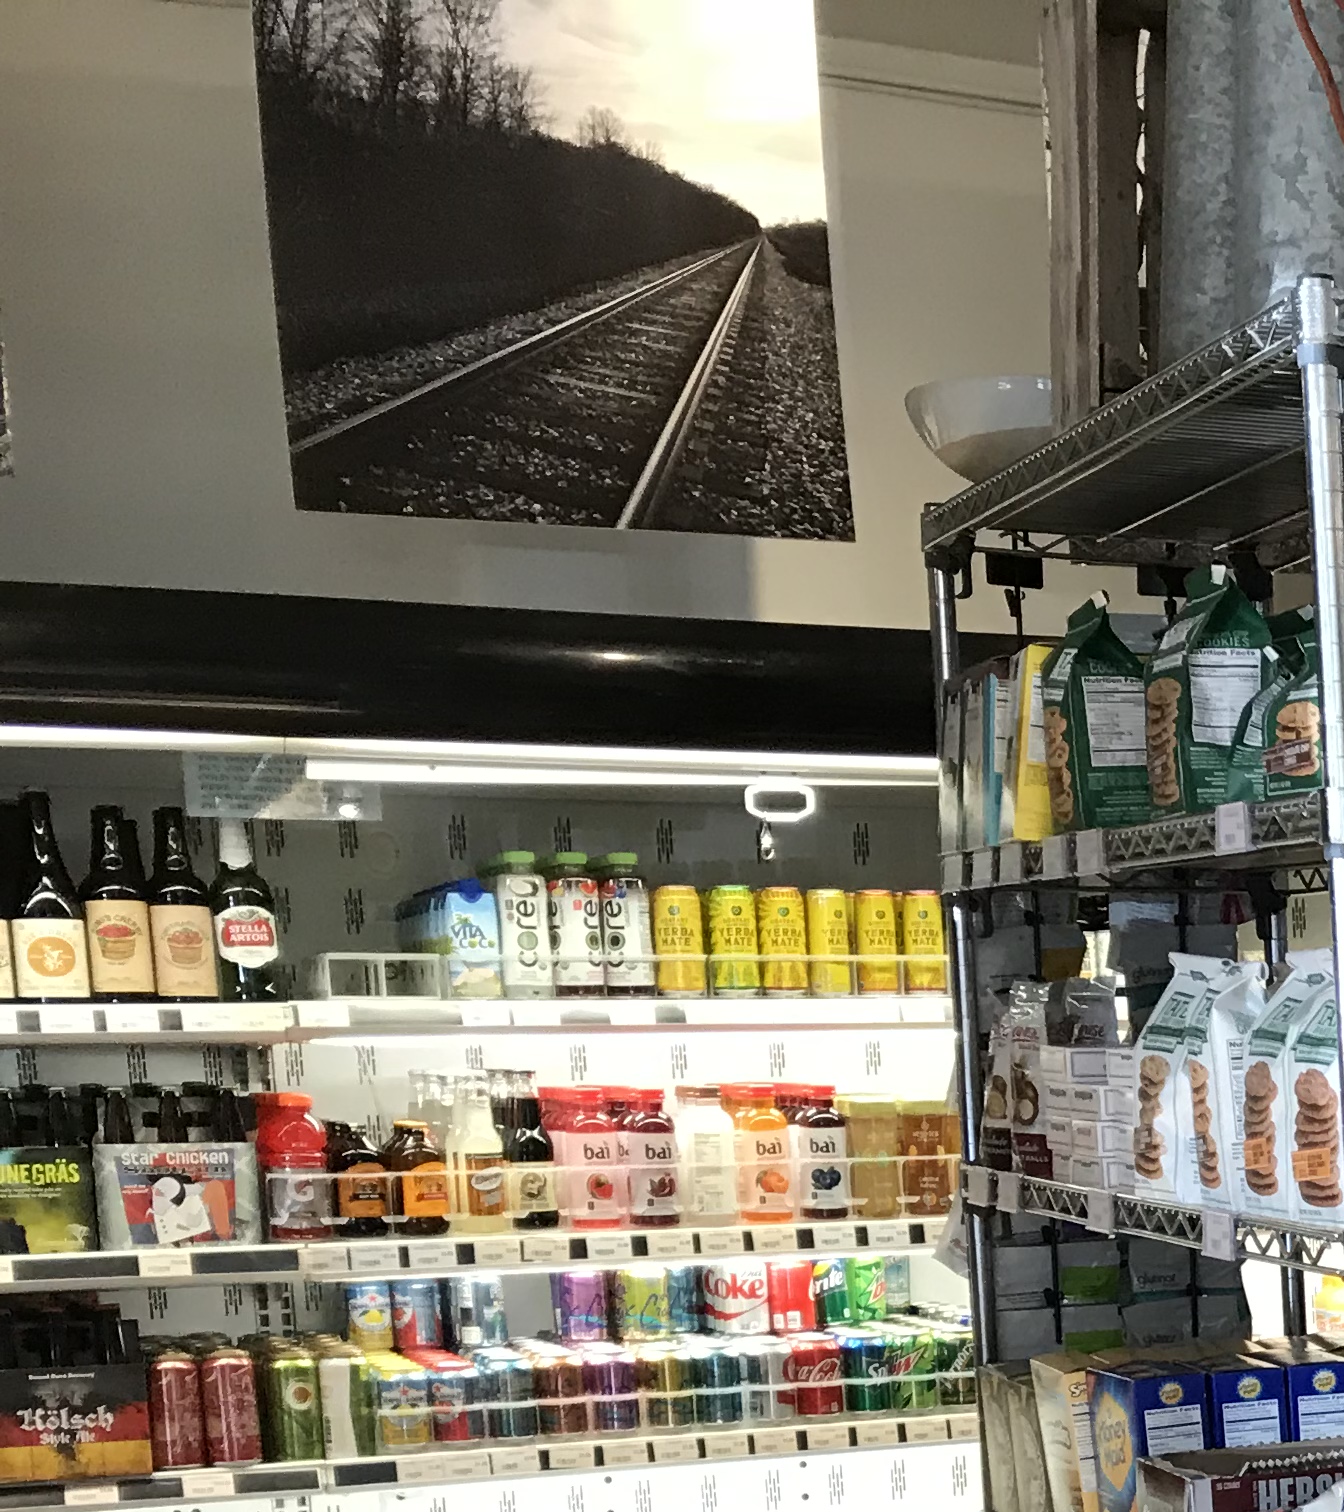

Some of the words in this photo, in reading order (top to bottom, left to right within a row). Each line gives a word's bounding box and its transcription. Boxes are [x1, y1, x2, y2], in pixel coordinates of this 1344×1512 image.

[228, 924, 268, 934] STELLA
[451, 924, 487, 939] VITA
[657, 928, 695, 938] YERBA
[765, 928, 802, 938] YERBA
[908, 930, 940, 939] YERBA
[229, 933, 270, 943] ARTOIS
[661, 937, 692, 947] MATE
[722, 937, 752, 947] MATE
[770, 937, 800, 948] MATE
[755, 1136, 783, 1156] bai
[809, 1133, 837, 1154] bai
[584, 1143, 611, 1161] bai
[645, 1140, 673, 1160] bai
[703, 1267, 766, 1301] Coke
[16, 1404, 115, 1433] Kölsch
